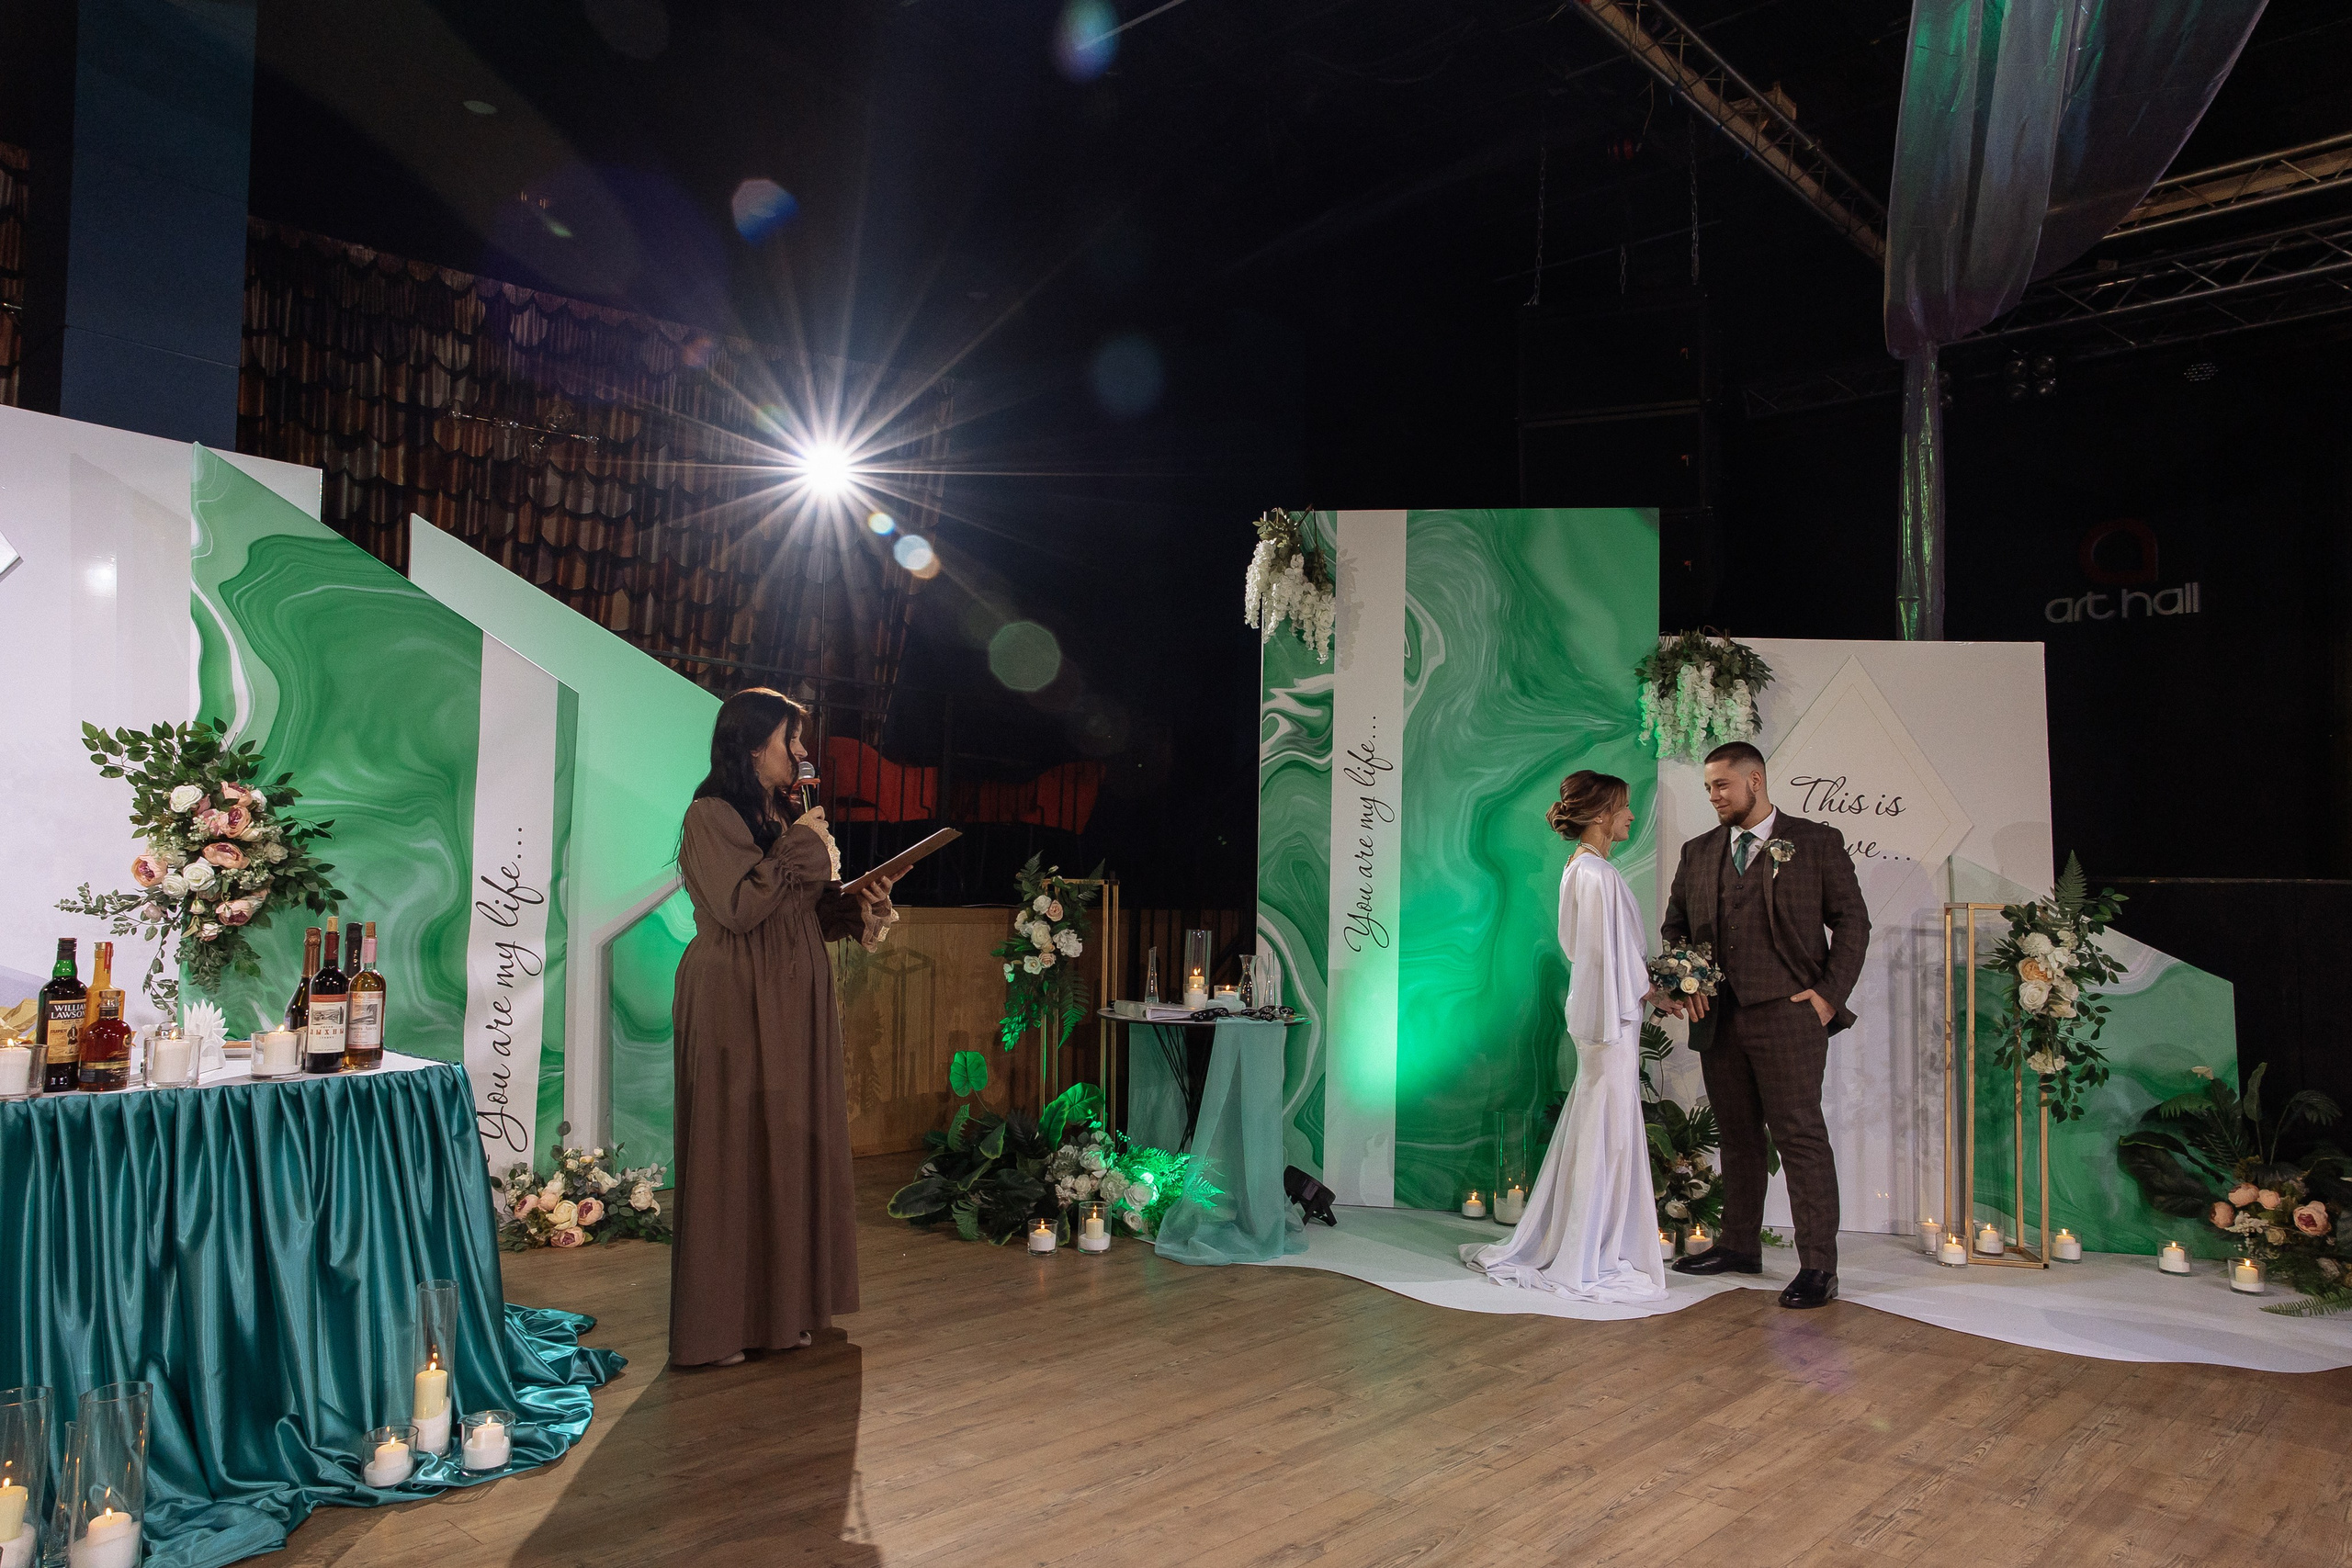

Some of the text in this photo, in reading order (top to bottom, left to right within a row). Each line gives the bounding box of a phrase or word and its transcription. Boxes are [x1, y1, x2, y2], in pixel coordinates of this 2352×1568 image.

[2044, 581, 2200, 624] art hall
[1342, 716, 1396, 953] You are my life...
[1790, 775, 1906, 817] This is
[475, 827, 545, 1165] You are my life...
